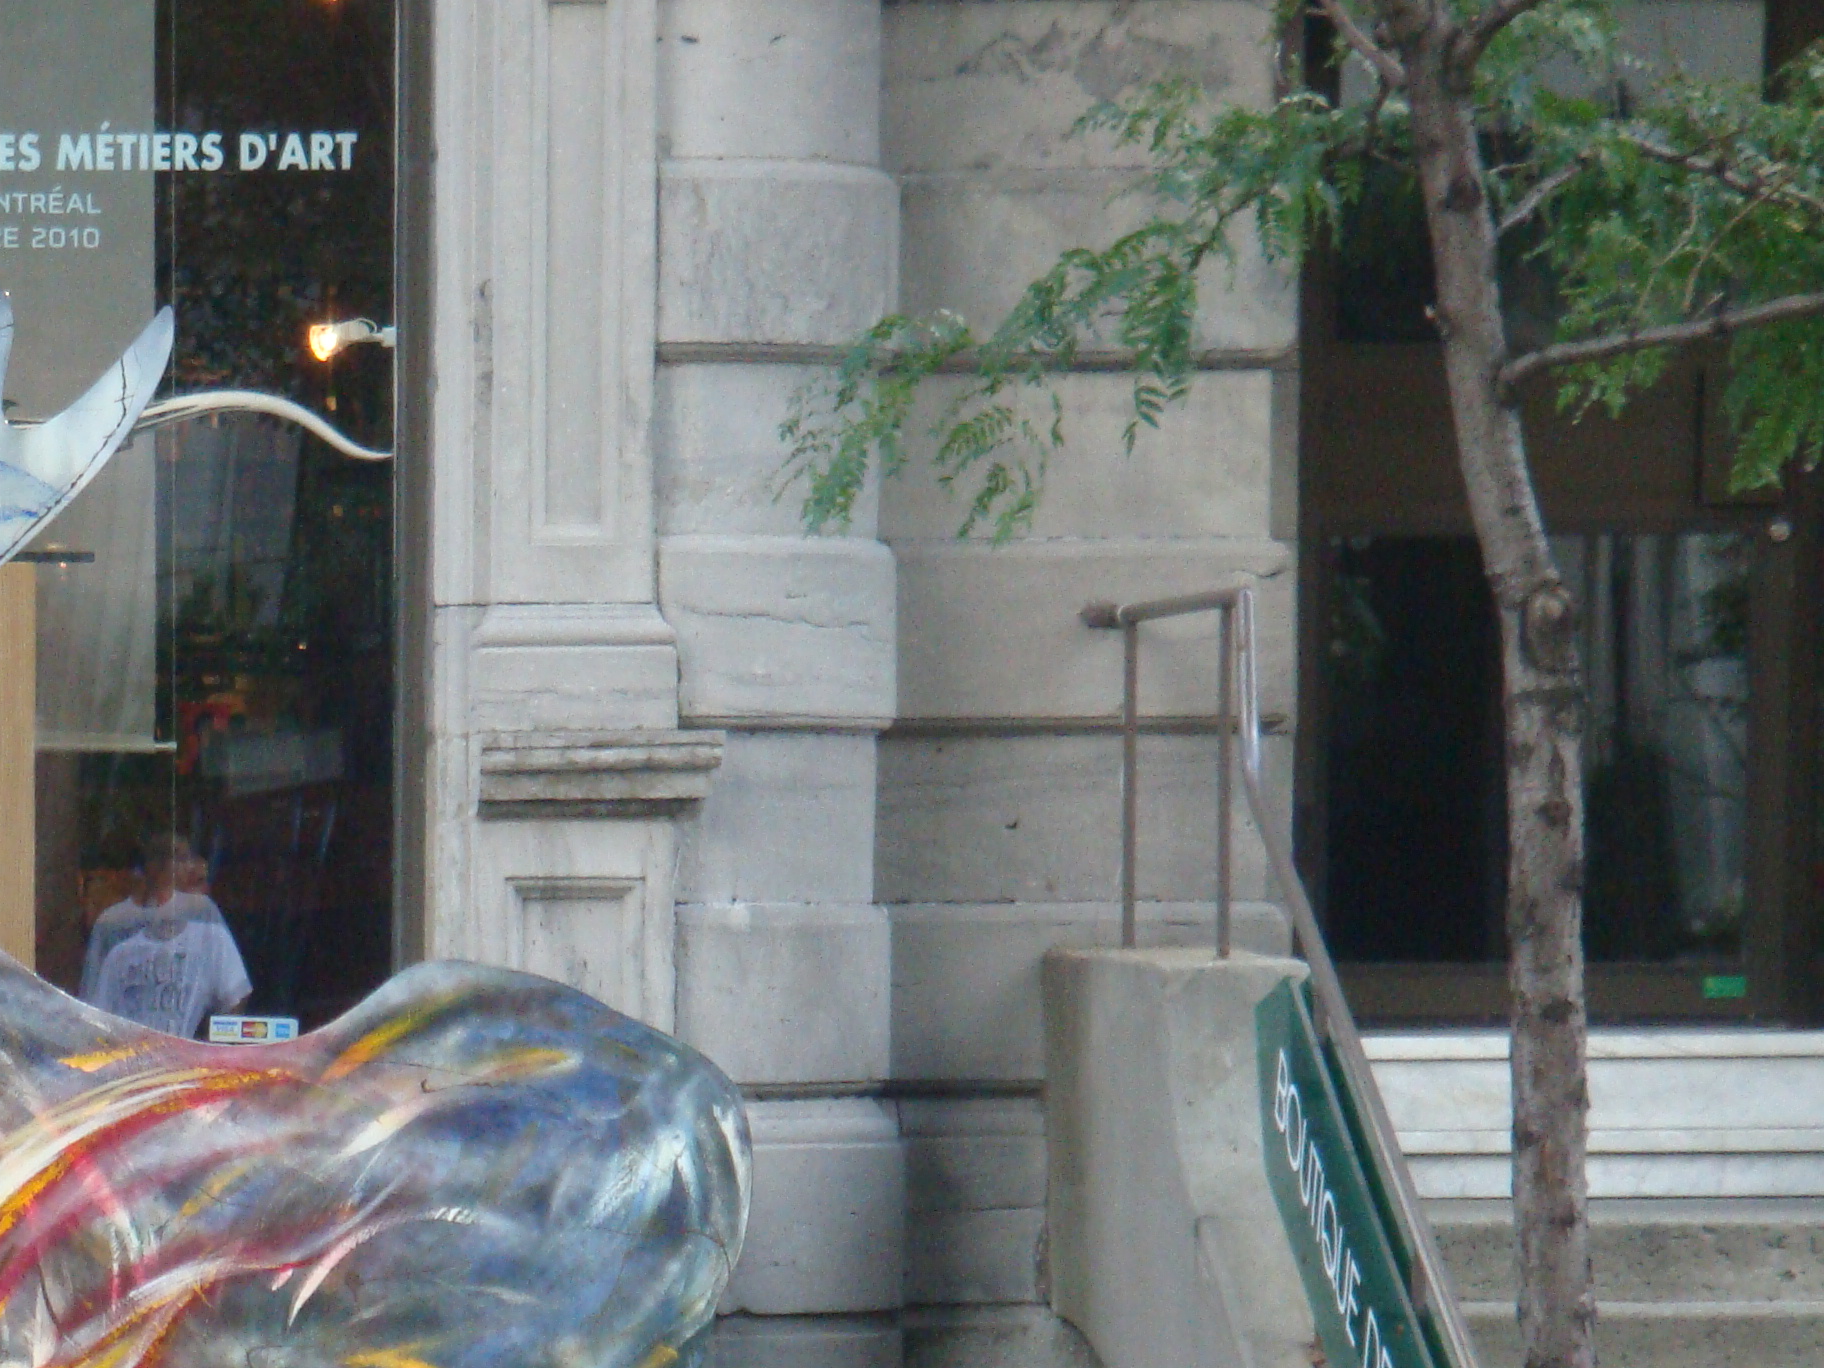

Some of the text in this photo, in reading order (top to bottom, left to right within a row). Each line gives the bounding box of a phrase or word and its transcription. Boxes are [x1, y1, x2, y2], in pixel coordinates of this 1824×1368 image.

[56, 121, 224, 172] MÉTIERS
[239, 132, 358, 171] D'ART
[32, 227, 101, 249] 2010
[1275, 1047, 1363, 1349] BOUTIQUE
